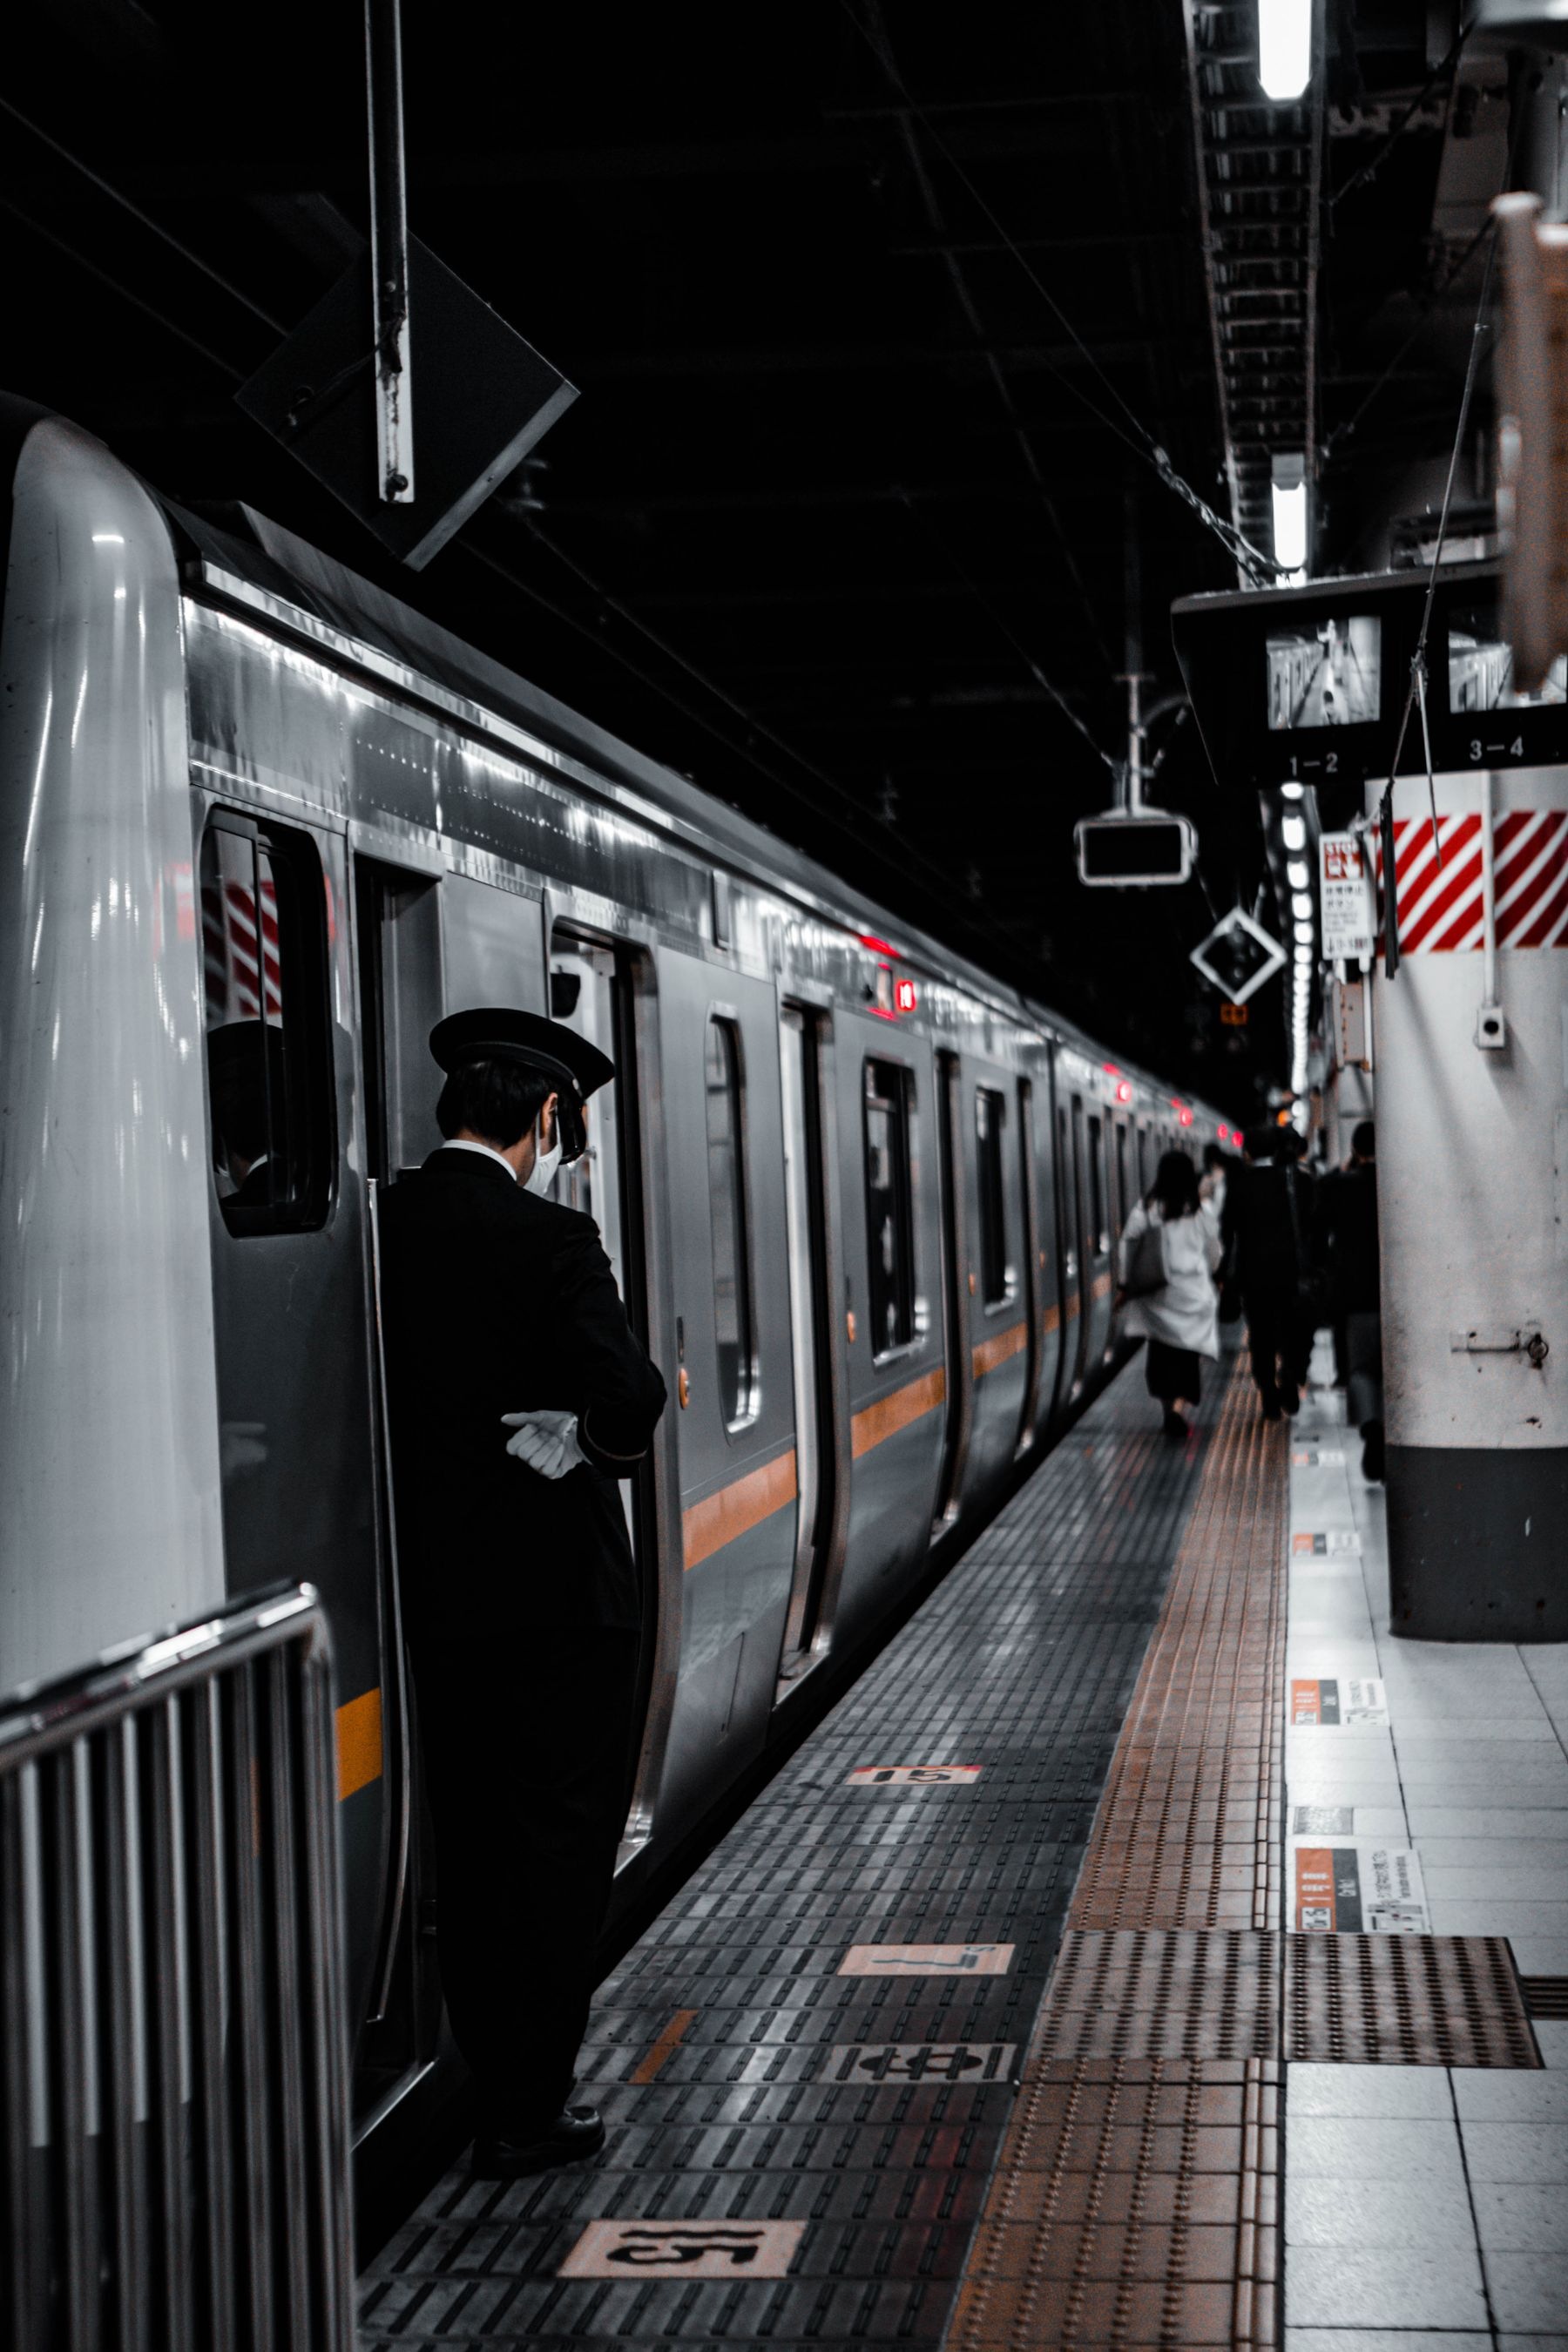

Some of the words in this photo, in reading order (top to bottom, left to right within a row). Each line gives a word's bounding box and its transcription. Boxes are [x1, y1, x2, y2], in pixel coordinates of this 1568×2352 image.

[1470, 736, 1524, 760] 3-4
[1289, 753, 1338, 776] 1-2
[873, 1769, 951, 1783] 15
[606, 2228, 765, 2265] 15
